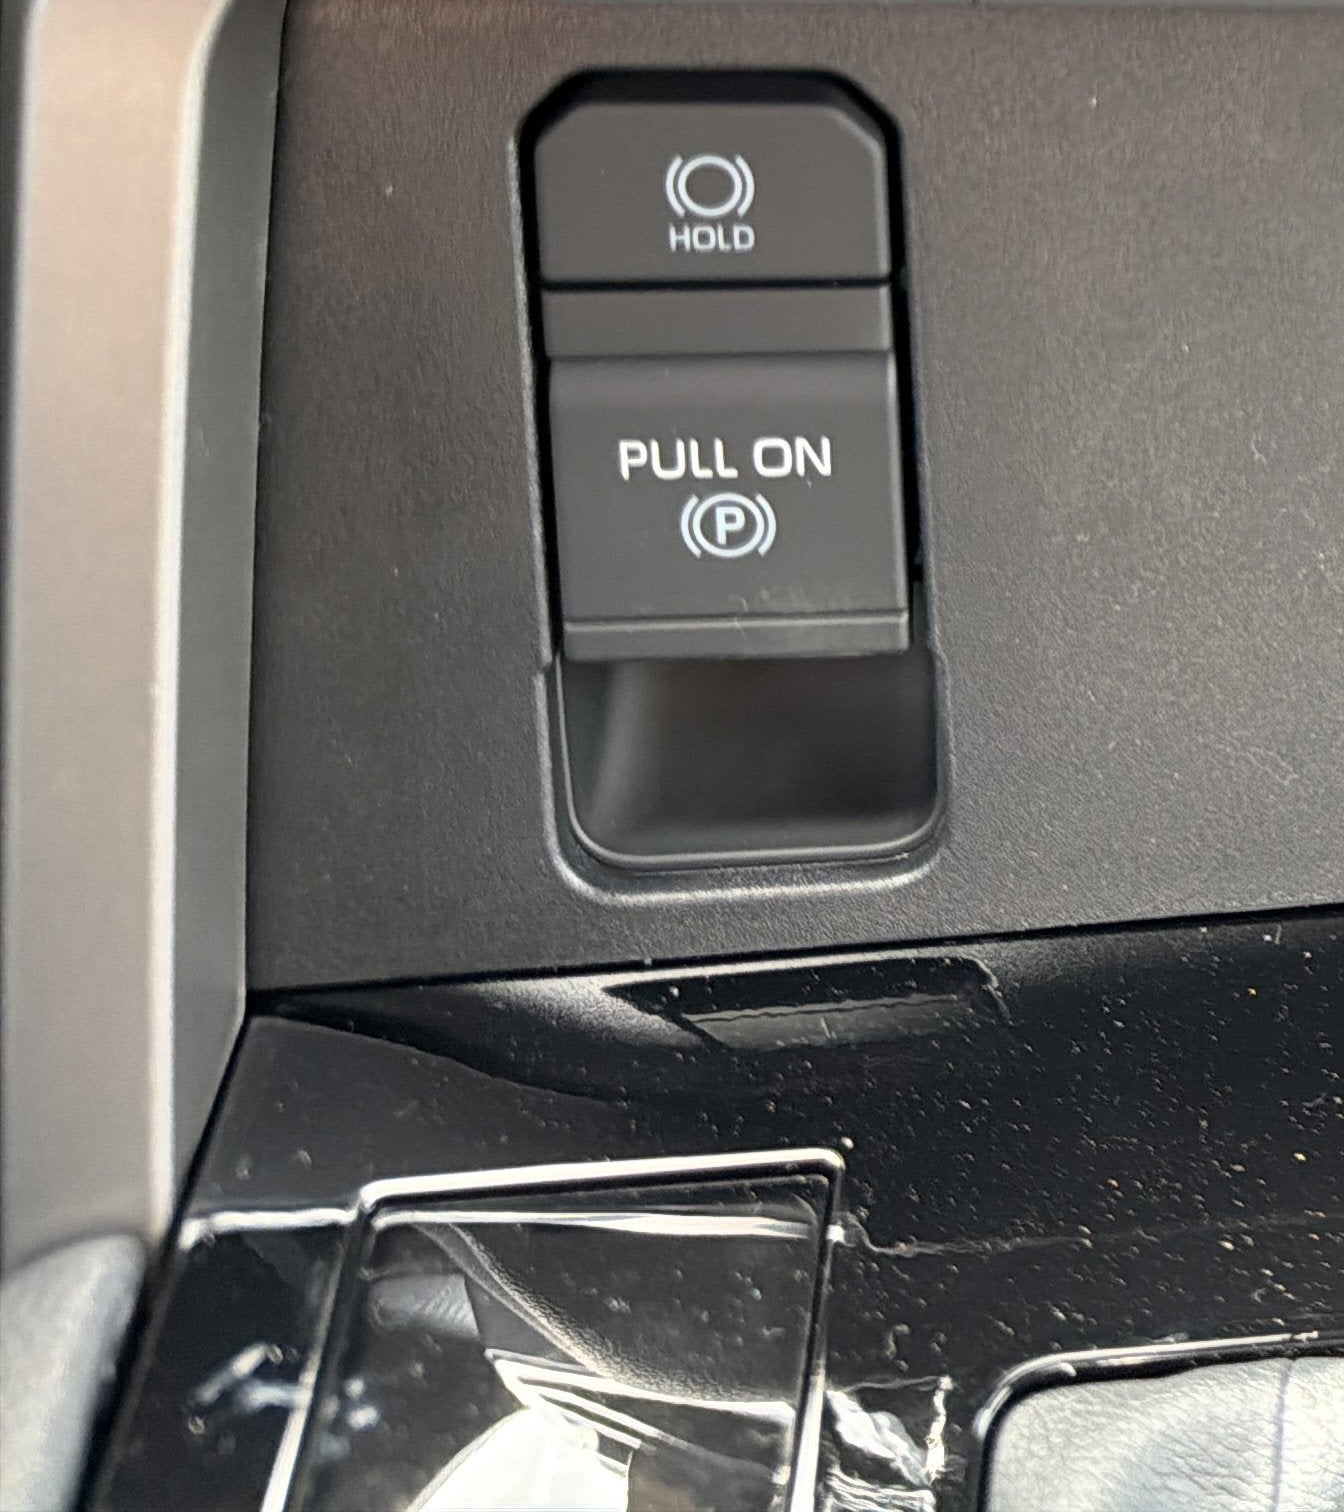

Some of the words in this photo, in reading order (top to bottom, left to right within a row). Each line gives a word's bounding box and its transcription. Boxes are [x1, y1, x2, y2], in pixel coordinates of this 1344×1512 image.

[668, 223, 755, 253] HOLD
[618, 437, 739, 481] PULL
[752, 435, 832, 478] ON
